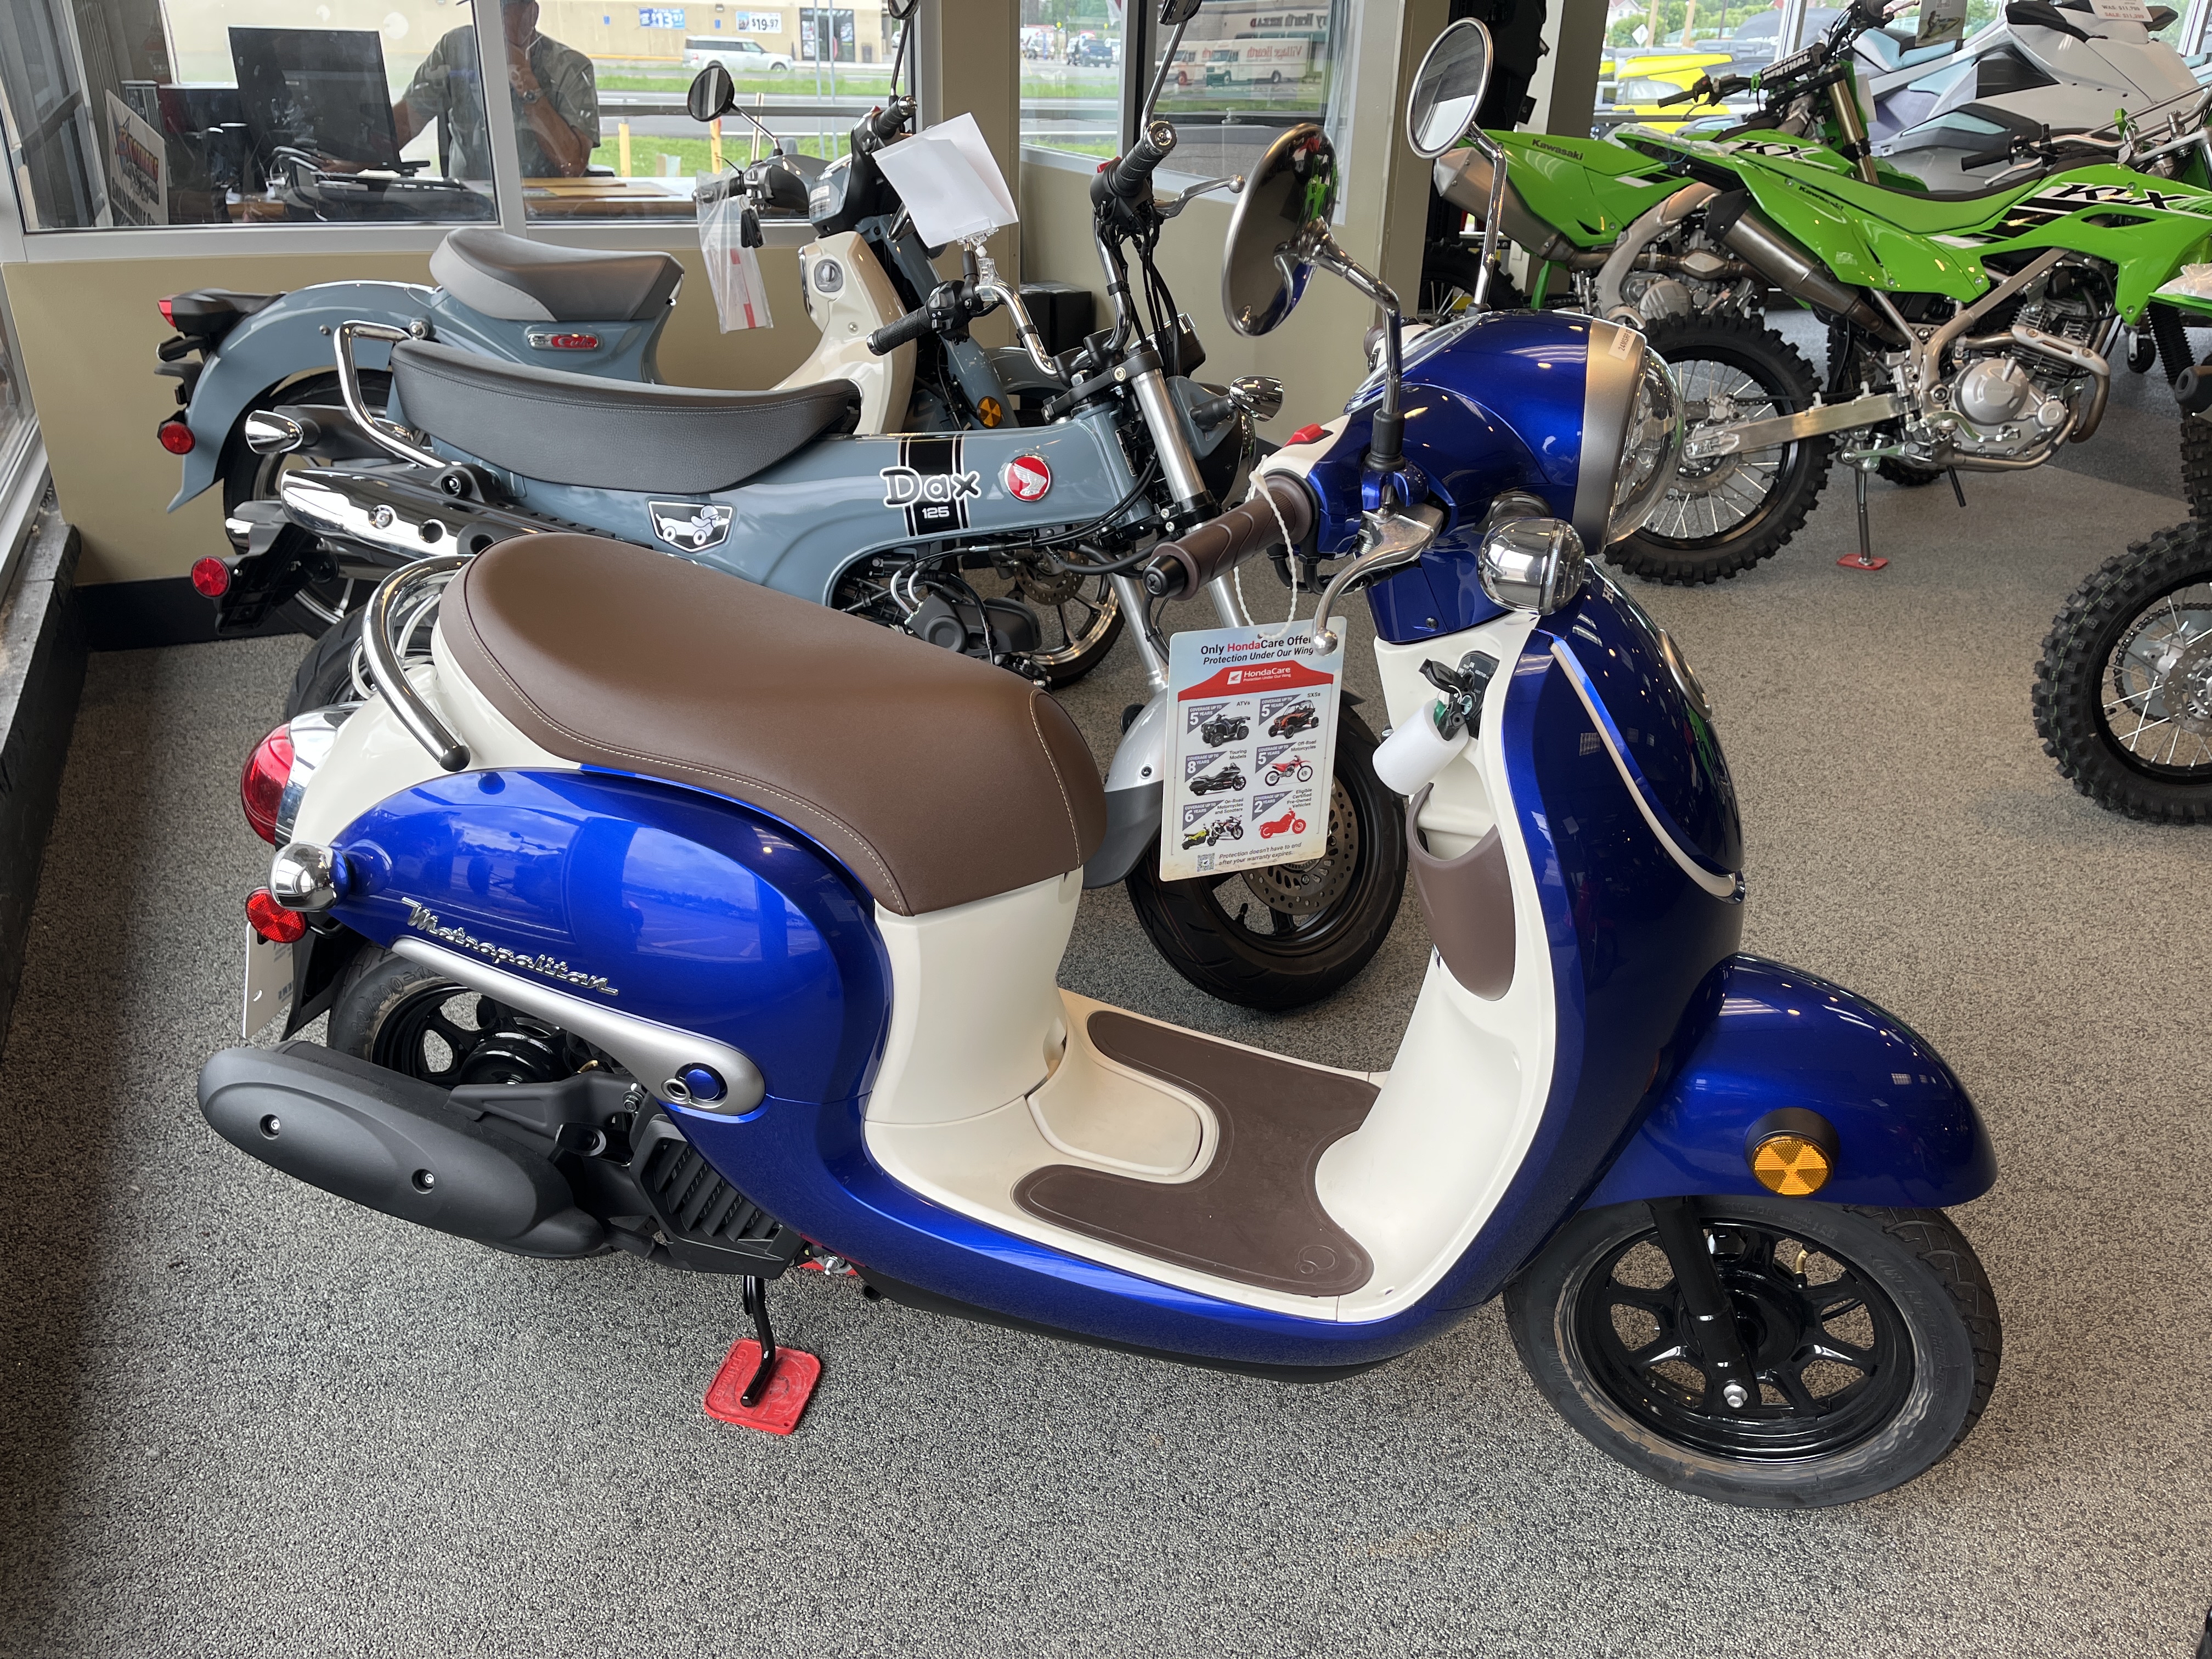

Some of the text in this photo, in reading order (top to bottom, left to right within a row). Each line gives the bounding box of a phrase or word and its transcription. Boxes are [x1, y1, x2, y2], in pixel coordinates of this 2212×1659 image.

[1532, 138, 1584, 161] Kawasaki
[879, 466, 982, 508] Dax
[922, 506, 950, 519] 125
[1201, 644, 1224, 656] Only
[1227, 639, 1284, 652] HondaCare
[1203, 653, 1248, 665] Protection
[1250, 650, 1275, 661] Under
[1294, 646, 1314, 656] Wing
[1244, 667, 1291, 678] HondaCare
[1261, 704, 1270, 717] 5
[1189, 712, 1199, 725] 5
[1257, 752, 1267, 765] 5
[1187, 761, 1196, 774] 8
[1254, 800, 1263, 813] 2
[1185, 810, 1194, 822] 6
[1219, 851, 1248, 859] Protection
[1247, 853, 1272, 861] warranty
[401, 896, 619, 996] Metropolitan
